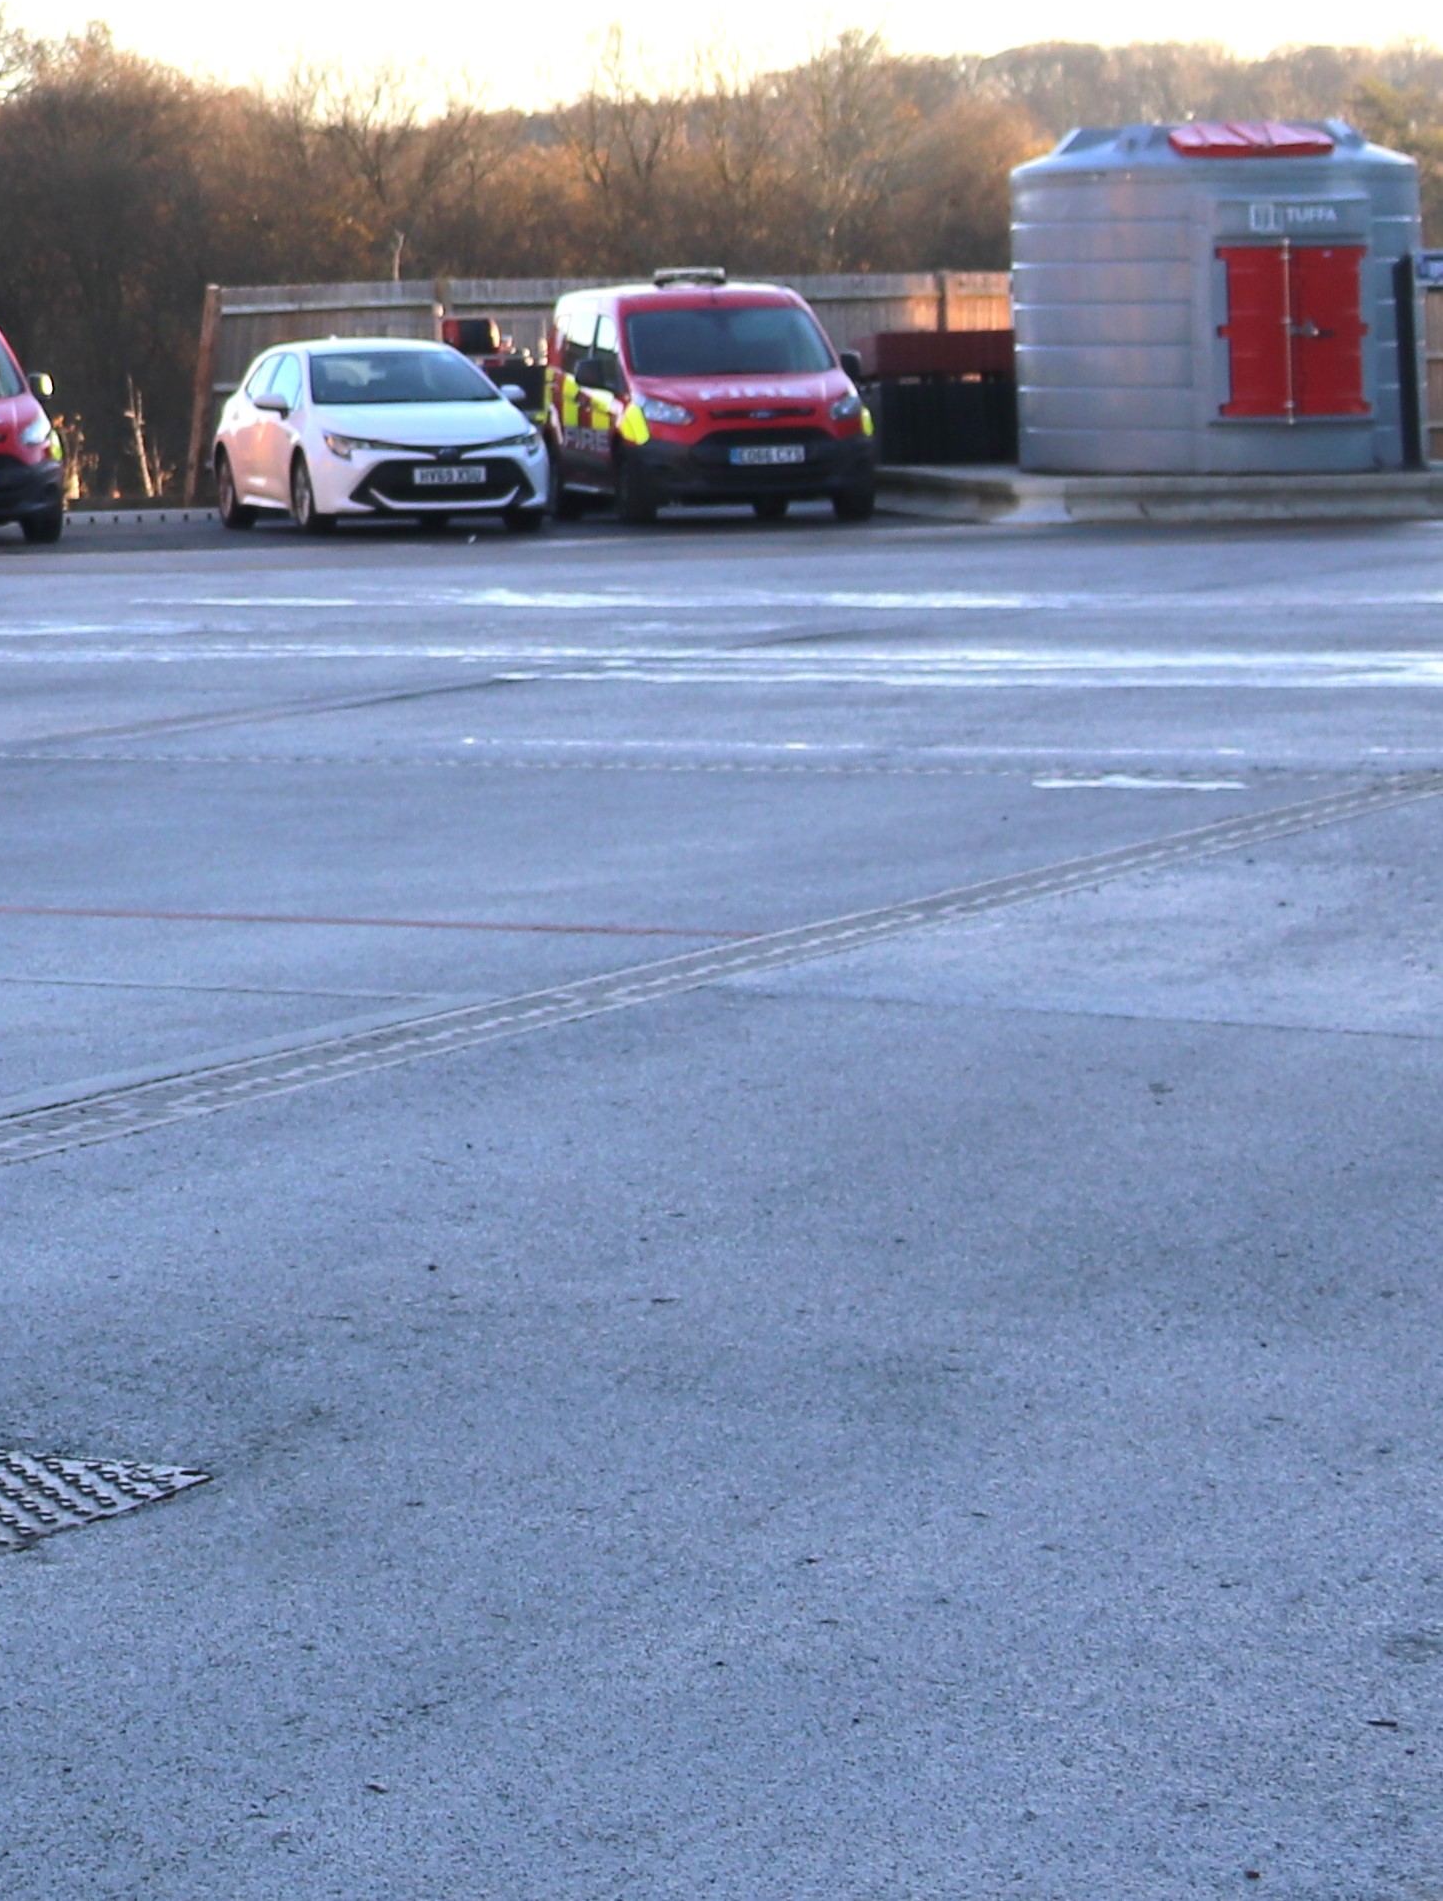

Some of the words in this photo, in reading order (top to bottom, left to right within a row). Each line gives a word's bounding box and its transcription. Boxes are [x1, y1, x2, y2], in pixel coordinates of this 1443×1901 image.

[1285, 206, 1338, 223] TUFFA
[698, 386, 810, 401] FIRE
[563, 425, 611, 452] FIRE
